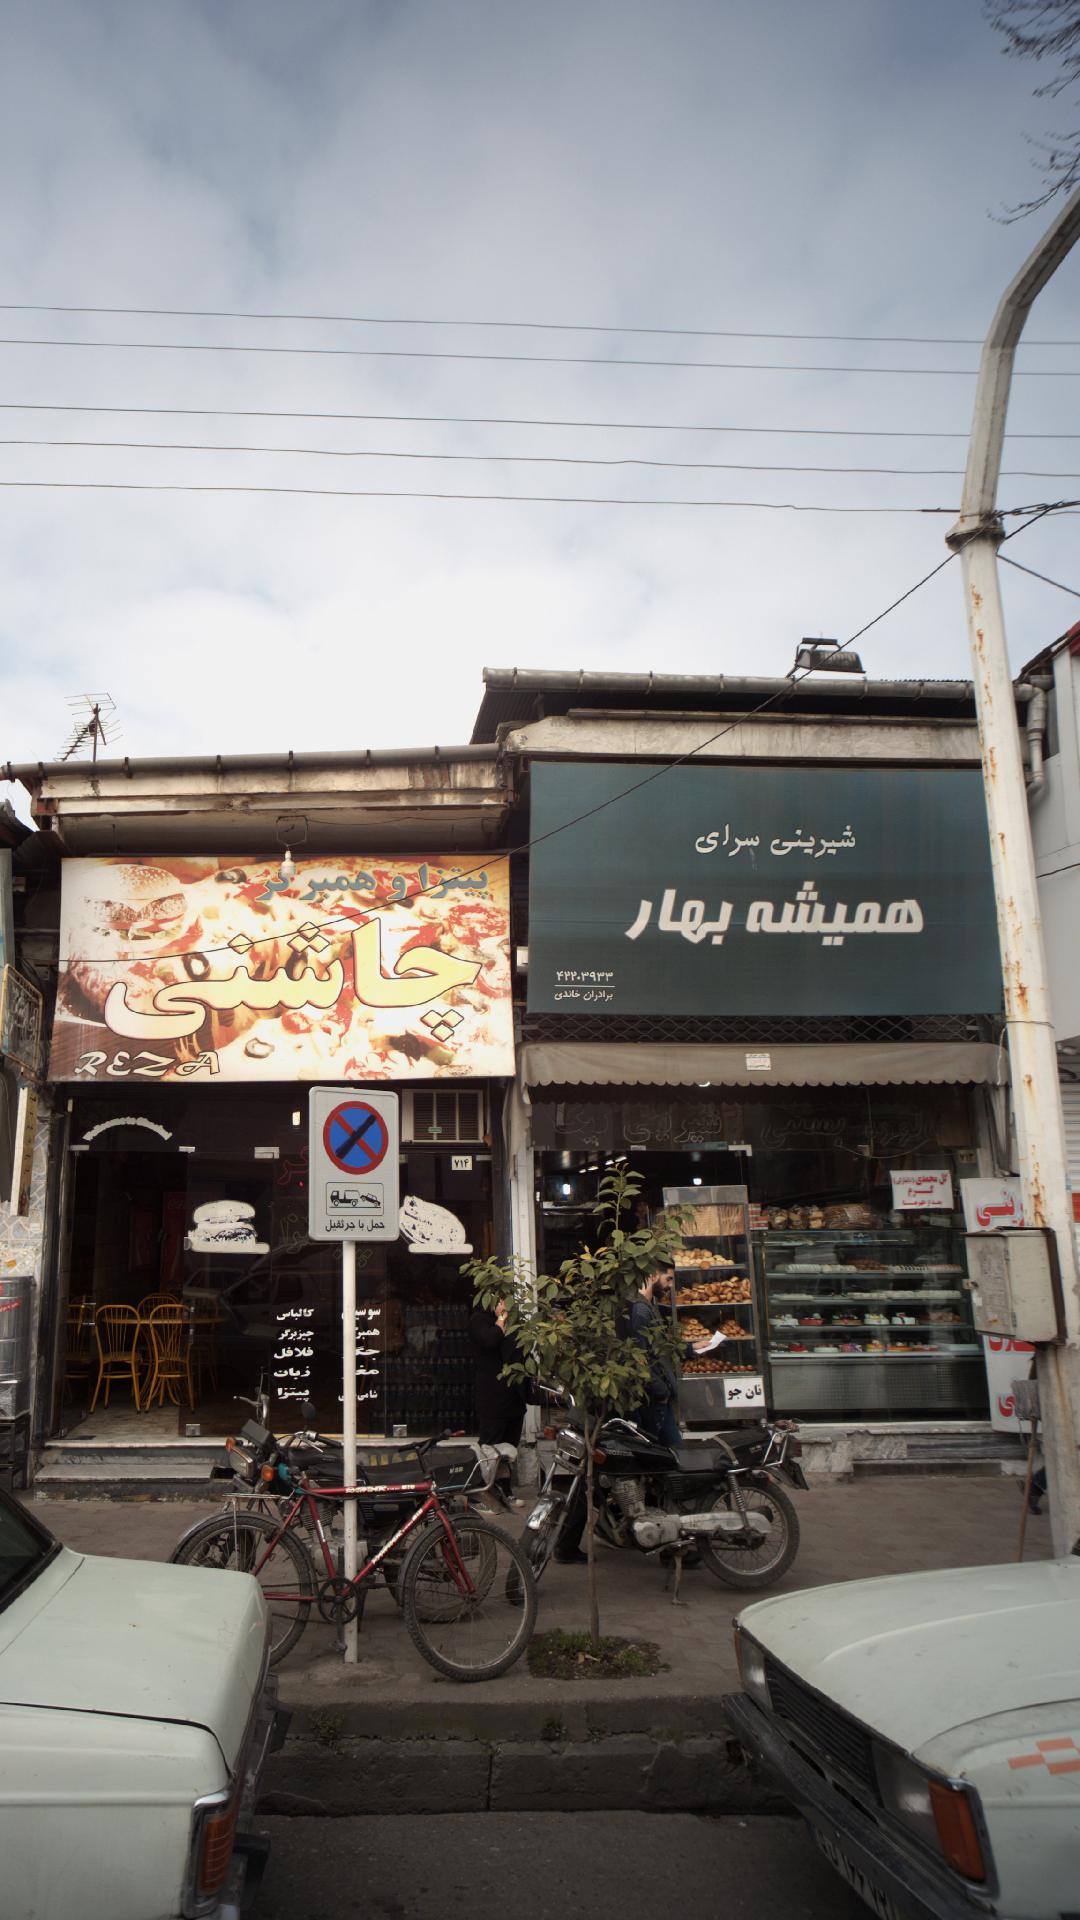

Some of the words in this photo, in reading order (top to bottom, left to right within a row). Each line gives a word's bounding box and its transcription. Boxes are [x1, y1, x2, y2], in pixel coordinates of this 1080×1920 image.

[694, 823, 760, 857] سرای
[769, 825, 857, 857] شیرینی
[387, 875, 407, 900] و
[418, 862, 489, 900] پیتزا
[624, 888, 734, 946] بهار
[745, 881, 924, 946] همیشه
[104, 917, 483, 1041] چاشنی
[583, 989, 614, 1002] برادران
[74, 1051, 220, 1078] REZA
[454, 1158, 469, 1169] ۷۱۴
[325, 1219, 356, 1232] جرثقیل
[358, 1220, 365, 1232] با
[367, 1220, 385, 1232] حمل
[276, 1308, 315, 1320] کالباس
[278, 1328, 315, 1341] چیزبرگر
[273, 1346, 314, 1359] فلافل
[277, 1387, 310, 1402] پیتزا
[728, 1387, 742, 1400] جو
[745, 1384, 762, 1399] نان
